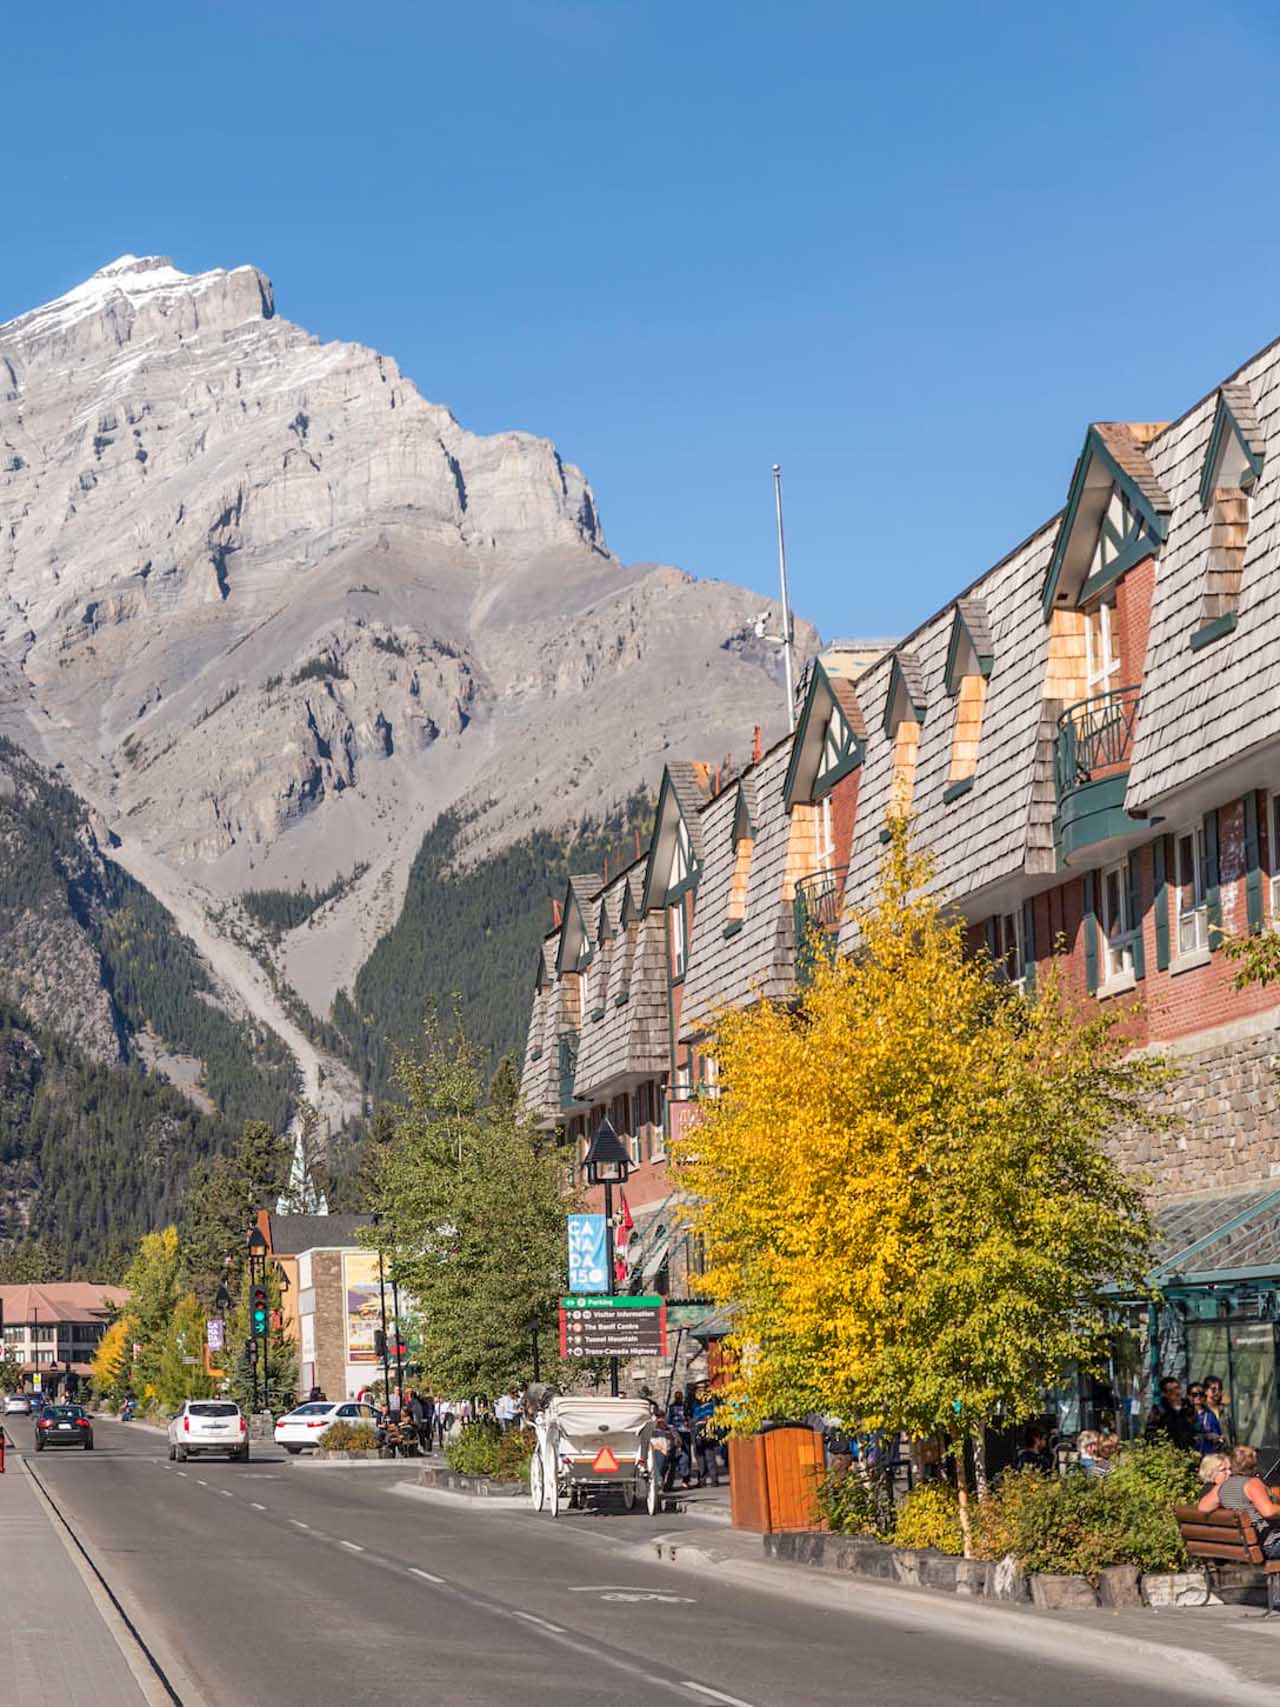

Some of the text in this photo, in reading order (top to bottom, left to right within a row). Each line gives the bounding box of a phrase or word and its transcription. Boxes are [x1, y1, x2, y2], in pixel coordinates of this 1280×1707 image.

[568, 1220, 593, 1235] CA
[569, 1235, 594, 1251] NA
[569, 1253, 595, 1268] DA
[587, 1298, 613, 1307] Parking
[584, 1335, 639, 1343] Tunnel Mountain
[584, 1347, 658, 1356] Trans-Canada Highway
